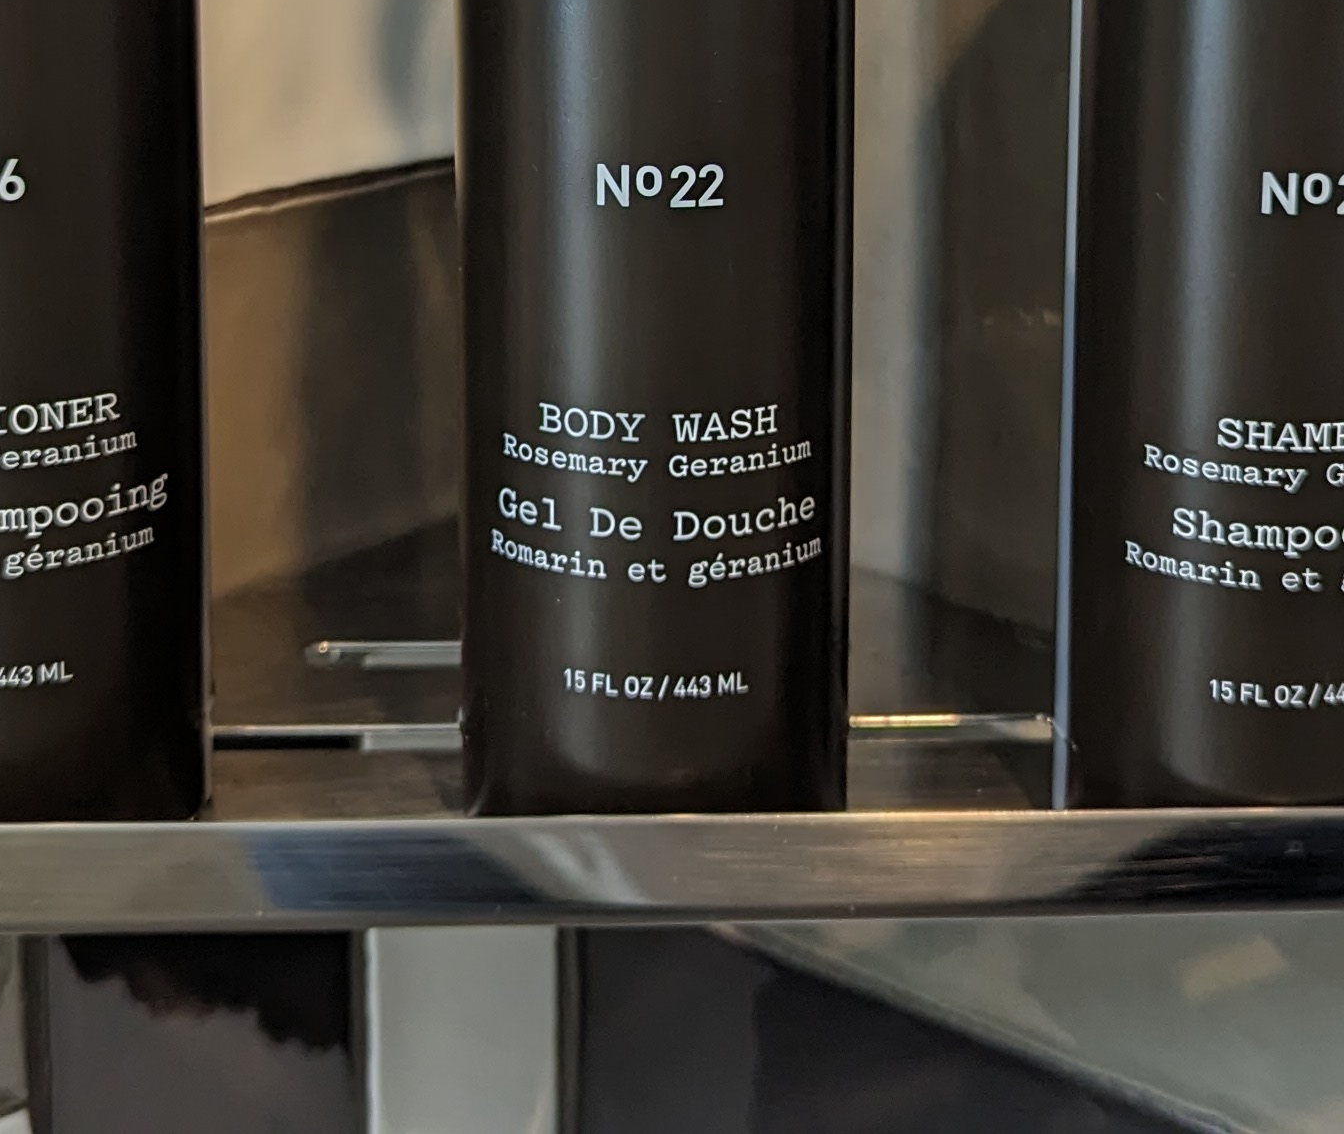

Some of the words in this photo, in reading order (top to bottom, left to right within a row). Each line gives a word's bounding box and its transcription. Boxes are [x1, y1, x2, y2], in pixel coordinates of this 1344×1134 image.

[538, 401, 646, 444] BODY
[671, 403, 779, 443] WASH
[502, 432, 649, 484] Rosemary
[668, 438, 813, 479] Geranium
[1143, 443, 1308, 494] Rosemary
[497, 487, 563, 533] Gel
[588, 506, 644, 542] De
[672, 495, 817, 542] Douche
[1, 524, 156, 580] géranium
[490, 528, 609, 580] Romarin
[626, 558, 668, 584] et
[686, 536, 824, 589] géranium
[1123, 538, 1264, 592] Romarin
[1280, 566, 1323, 593] et
[37, 660, 75, 684] ML
[561, 666, 587, 694] 15
[590, 671, 619, 697] FL
[716, 670, 750, 695] ML
[1207, 677, 1236, 704] 15
[1238, 681, 1270, 707] FL
